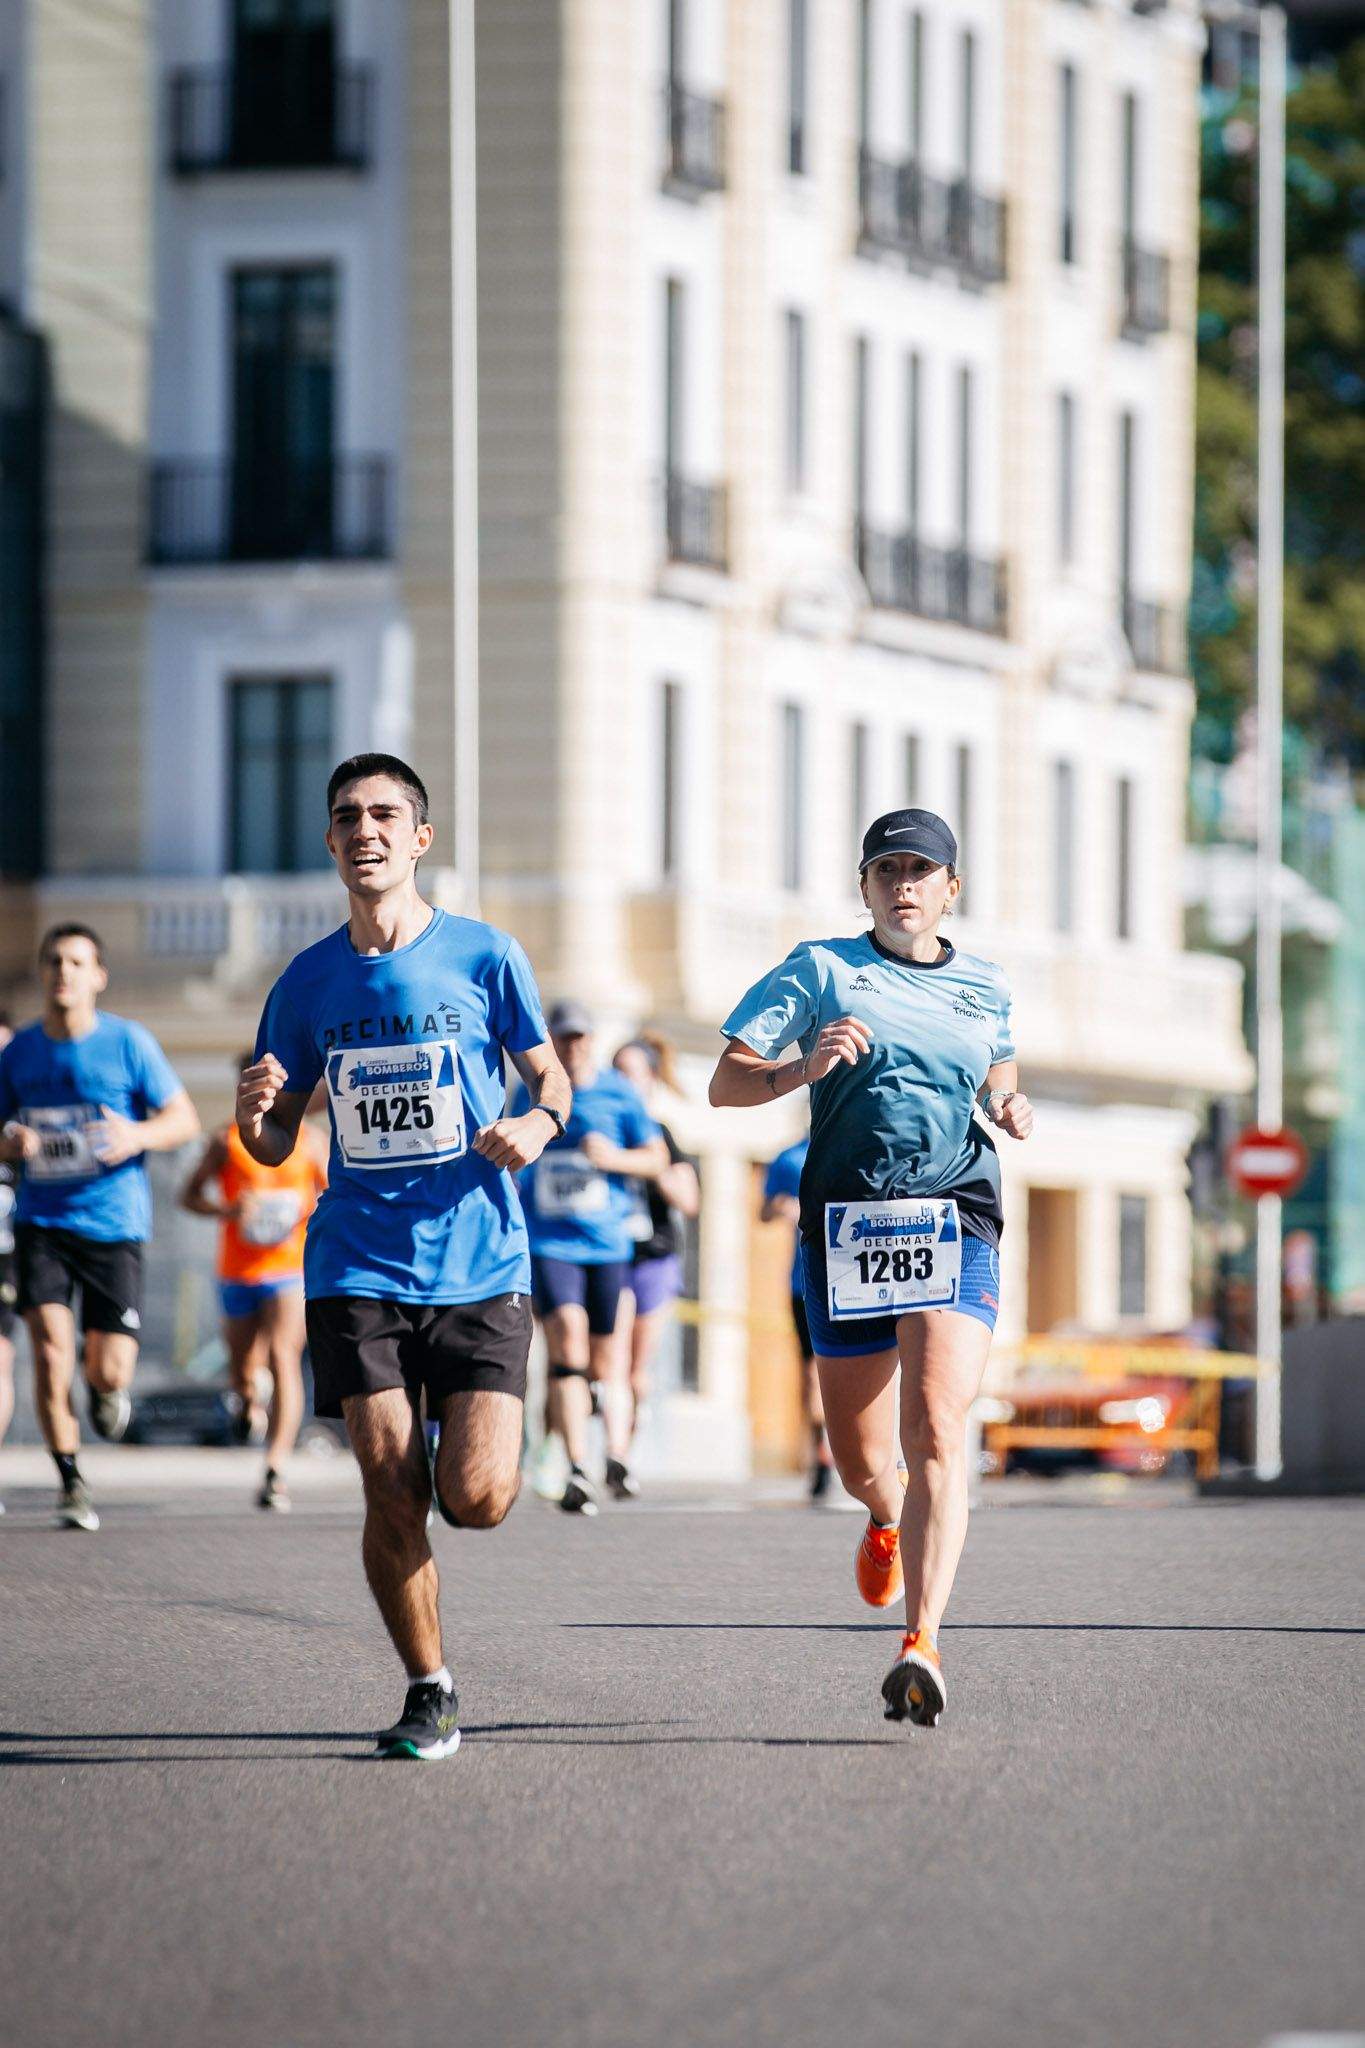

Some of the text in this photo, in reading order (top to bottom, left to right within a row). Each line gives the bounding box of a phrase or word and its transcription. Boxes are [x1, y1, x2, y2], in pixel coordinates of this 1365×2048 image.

[324, 1014, 462, 1047] DECIMAS
[366, 1062, 429, 1075] BOMBEROS
[361, 1082, 429, 1096] DECIMAS
[355, 1095, 434, 1134] 1425
[870, 1216, 932, 1227] BOMBEROS
[864, 1235, 932, 1247] DECIMAS
[854, 1248, 933, 1283] 1283
